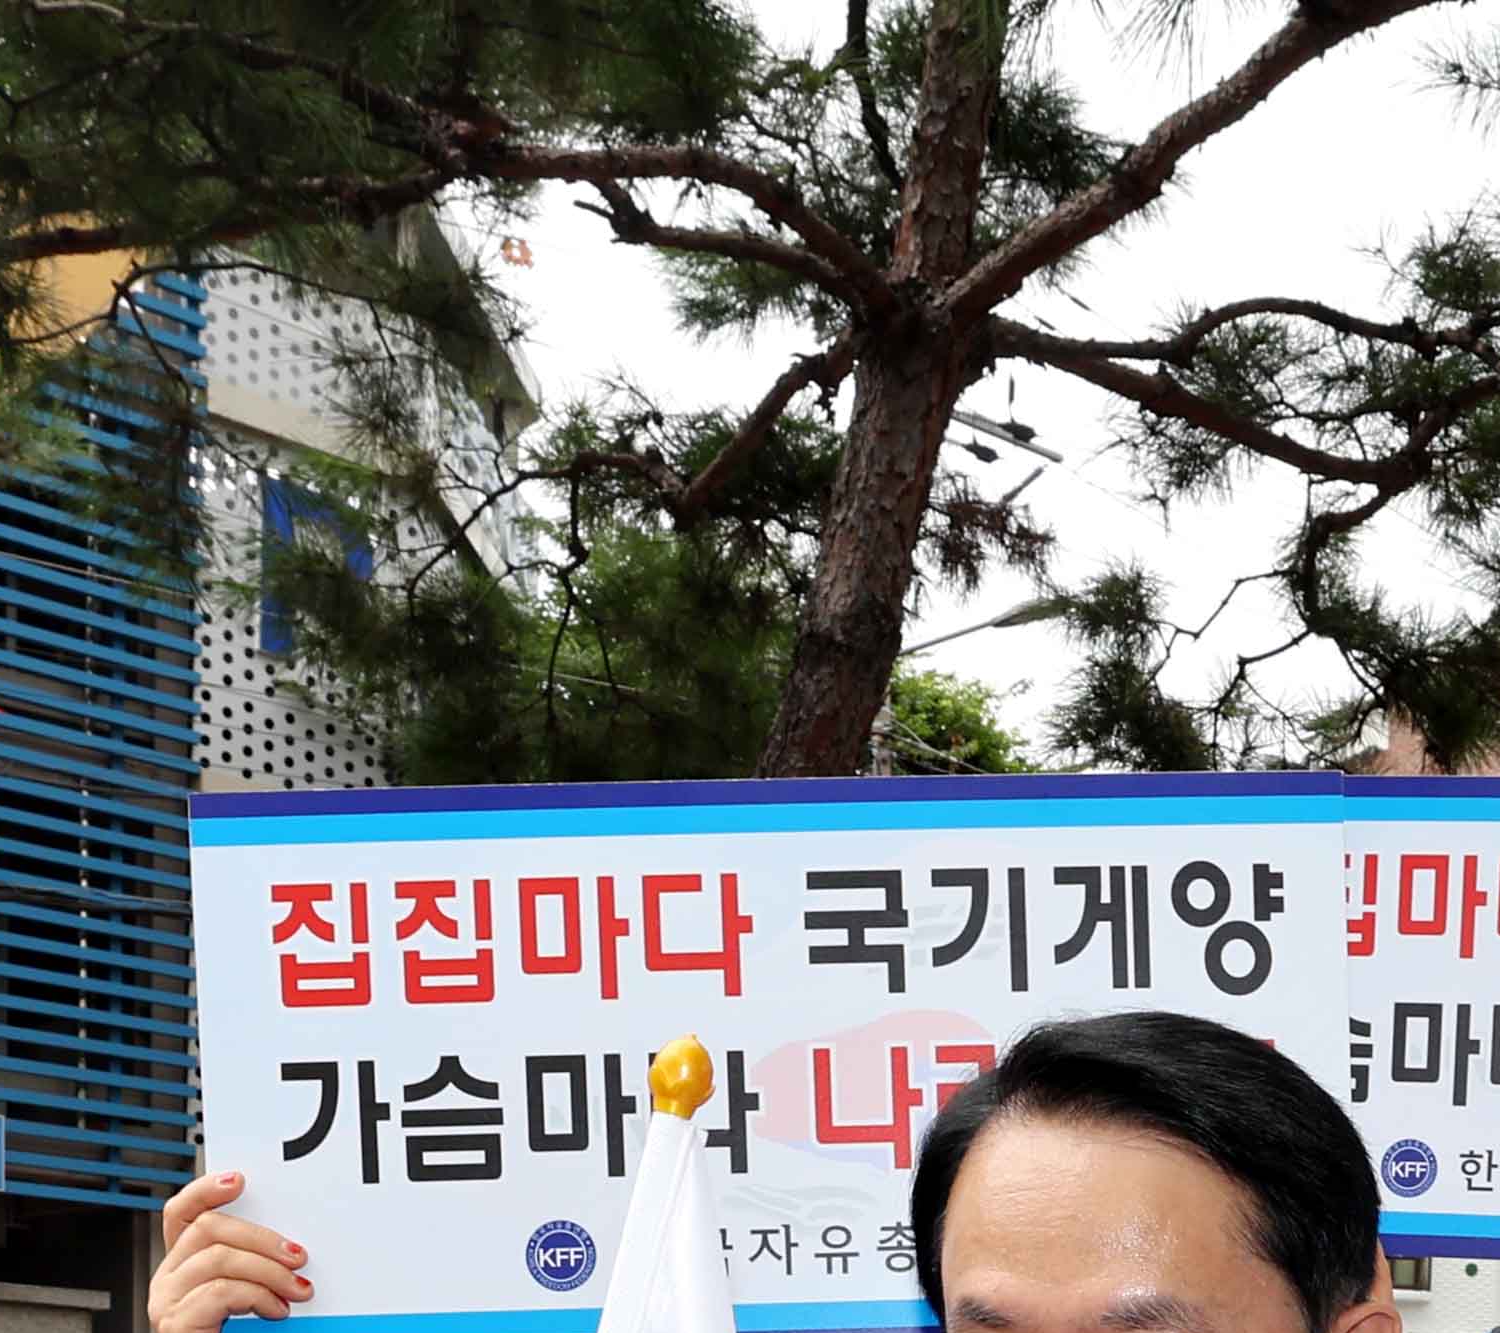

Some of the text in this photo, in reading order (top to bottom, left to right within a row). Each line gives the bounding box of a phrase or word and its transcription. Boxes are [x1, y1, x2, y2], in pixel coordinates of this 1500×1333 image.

[271, 859, 1286, 1009] 집집마다 국기게양
[539, 1248, 583, 1267] KFF
